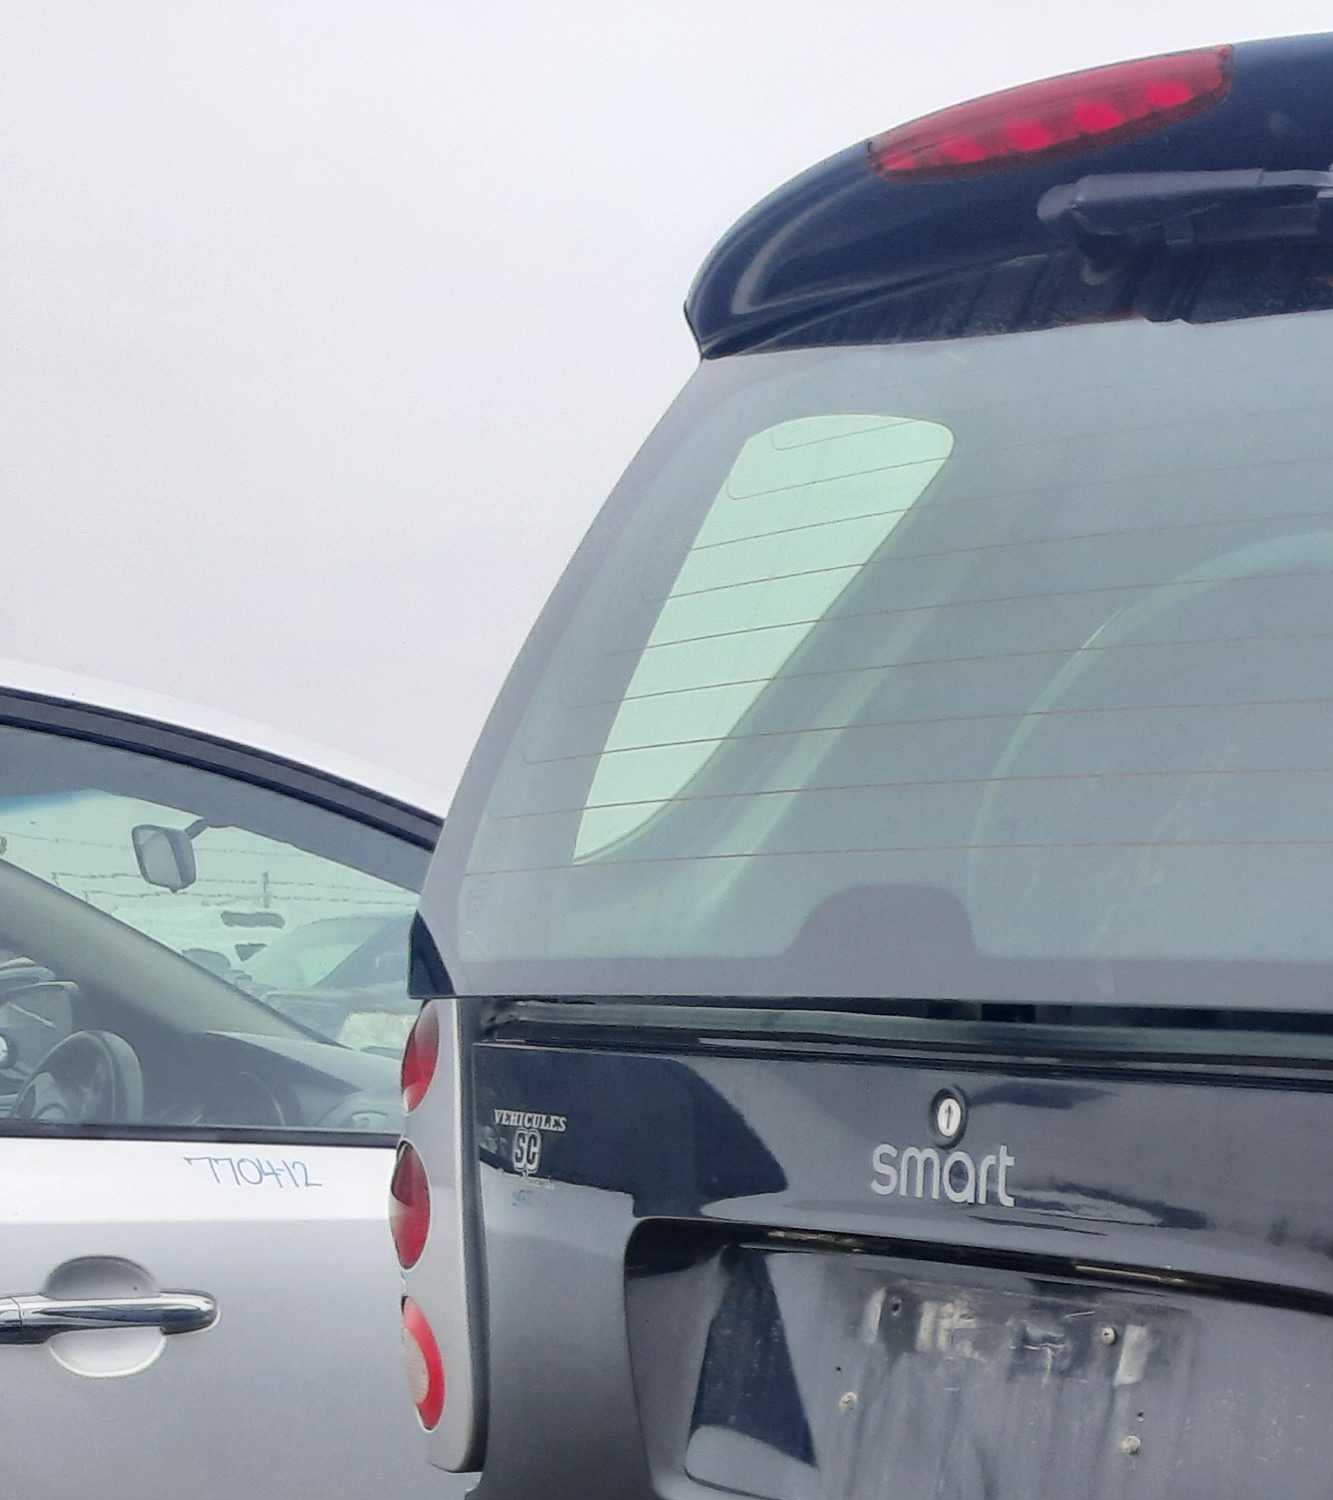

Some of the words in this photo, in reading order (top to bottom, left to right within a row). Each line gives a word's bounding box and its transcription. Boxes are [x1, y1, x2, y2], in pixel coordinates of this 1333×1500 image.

[494, 1108, 567, 1132] VEHICULES
[512, 1127, 541, 1174] SC
[870, 1143, 1016, 1208] smart
